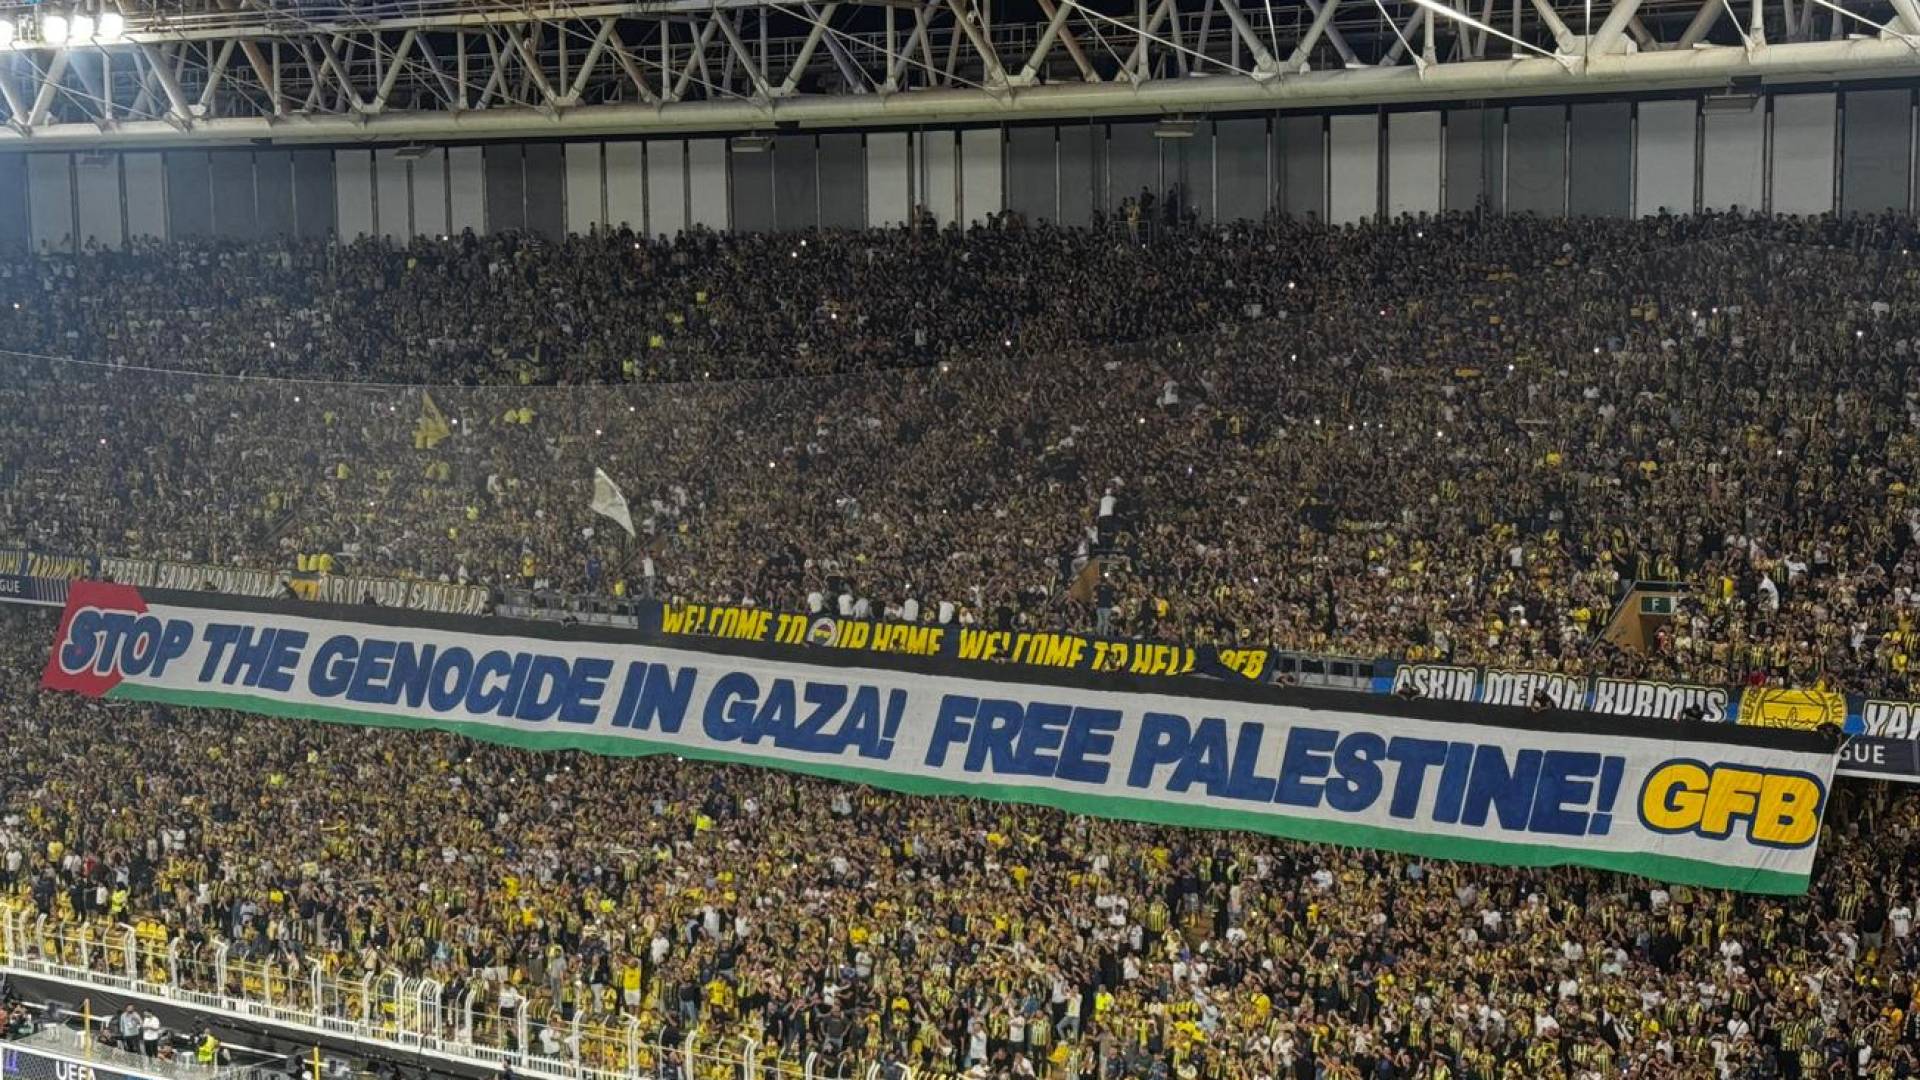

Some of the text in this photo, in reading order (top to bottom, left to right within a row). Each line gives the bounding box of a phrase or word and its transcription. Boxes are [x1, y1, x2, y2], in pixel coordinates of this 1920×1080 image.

[1651, 598, 1660, 610] F
[63, 612, 1825, 849] STOP THE GENOCIDE IN GAZA! FREE PALESTINE! GFB
